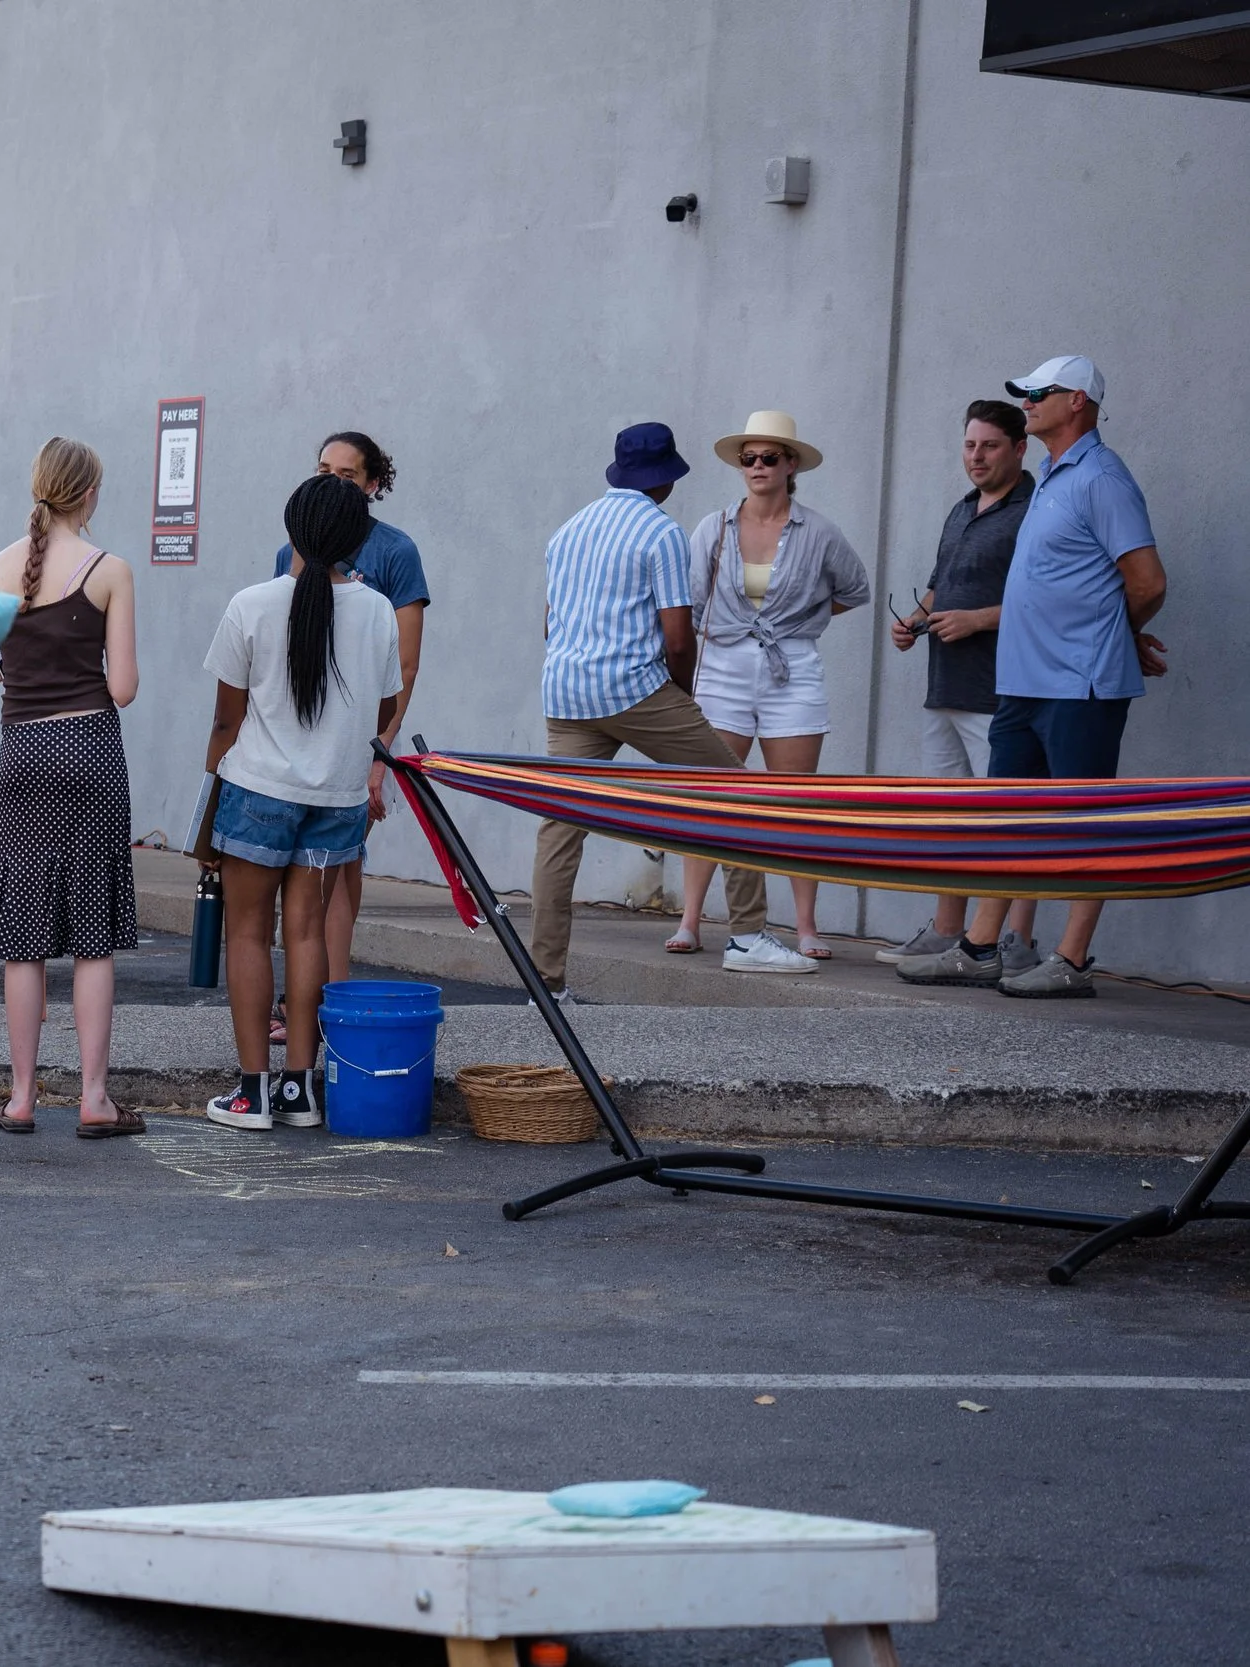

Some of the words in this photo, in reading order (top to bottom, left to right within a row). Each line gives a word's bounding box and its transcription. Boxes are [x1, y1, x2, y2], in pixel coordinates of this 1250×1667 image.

[162, 410, 178, 422] PAY
[178, 408, 199, 421] HERE
[155, 536, 179, 544] KINGDOM
[180, 535, 193, 544] CAFE
[159, 545, 189, 553] CUSTOMERS
